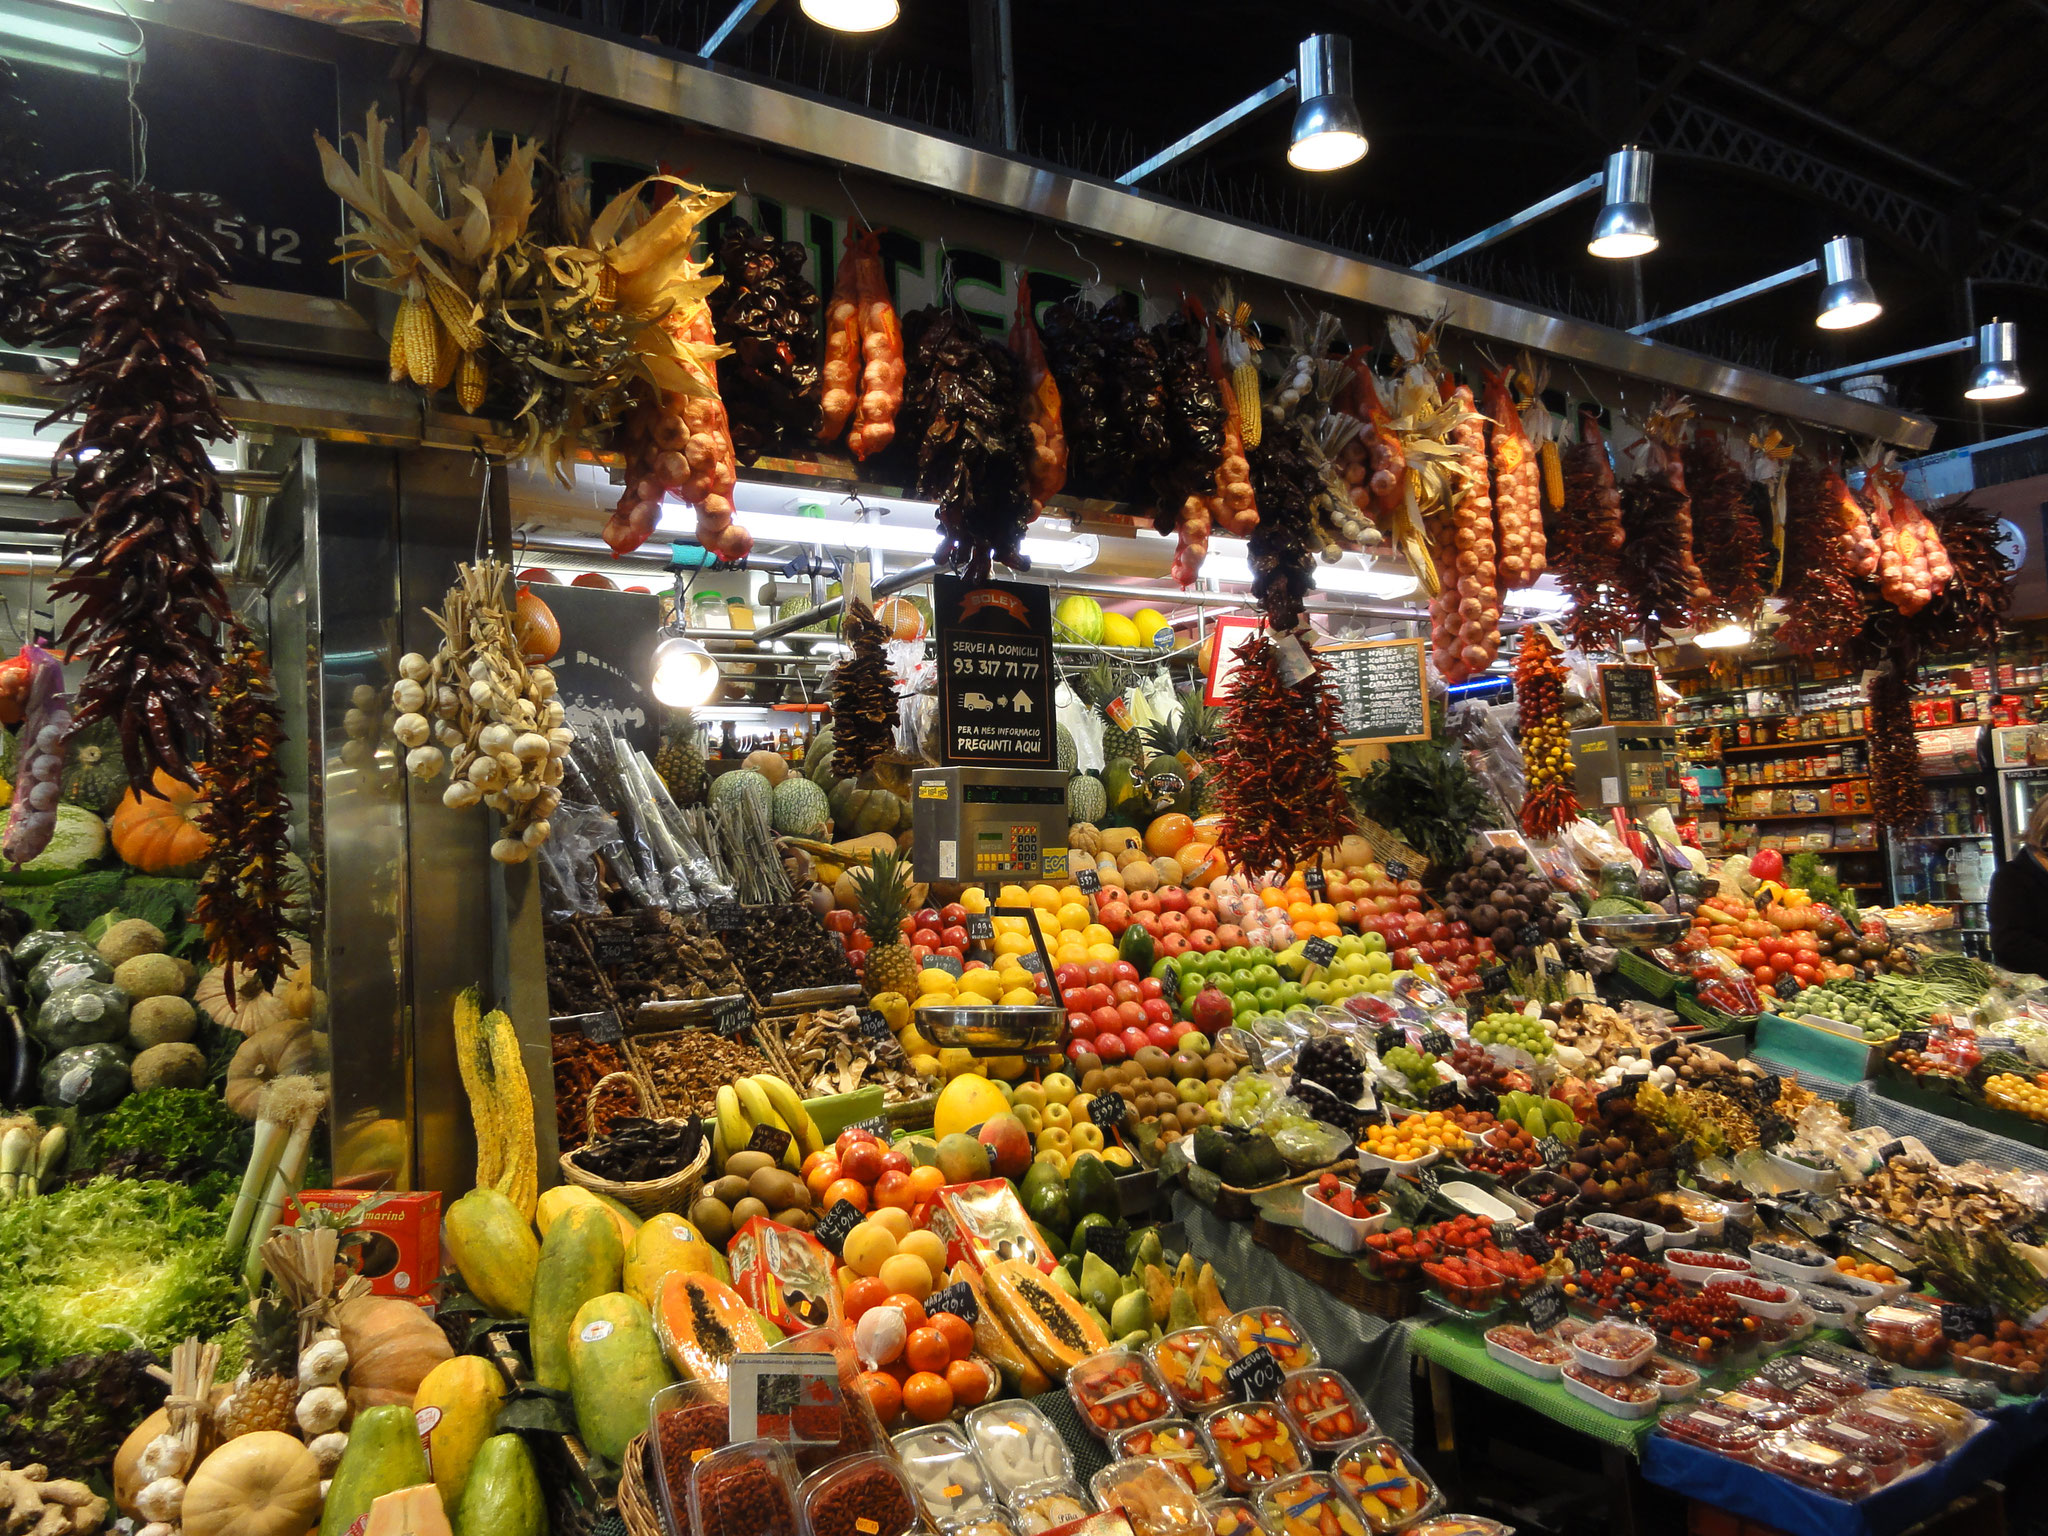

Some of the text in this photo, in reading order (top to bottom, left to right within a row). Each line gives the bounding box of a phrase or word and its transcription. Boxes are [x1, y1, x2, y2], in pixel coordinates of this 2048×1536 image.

[971, 593, 1018, 608] SOLEY
[952, 641, 1039, 658] SERVEI A DOMICILI
[953, 657, 1039, 680] 93 317 71 77
[957, 725, 973, 735] PER
[973, 725, 980, 735] A
[957, 737, 1042, 754] PREGUNTI AQUÍ
